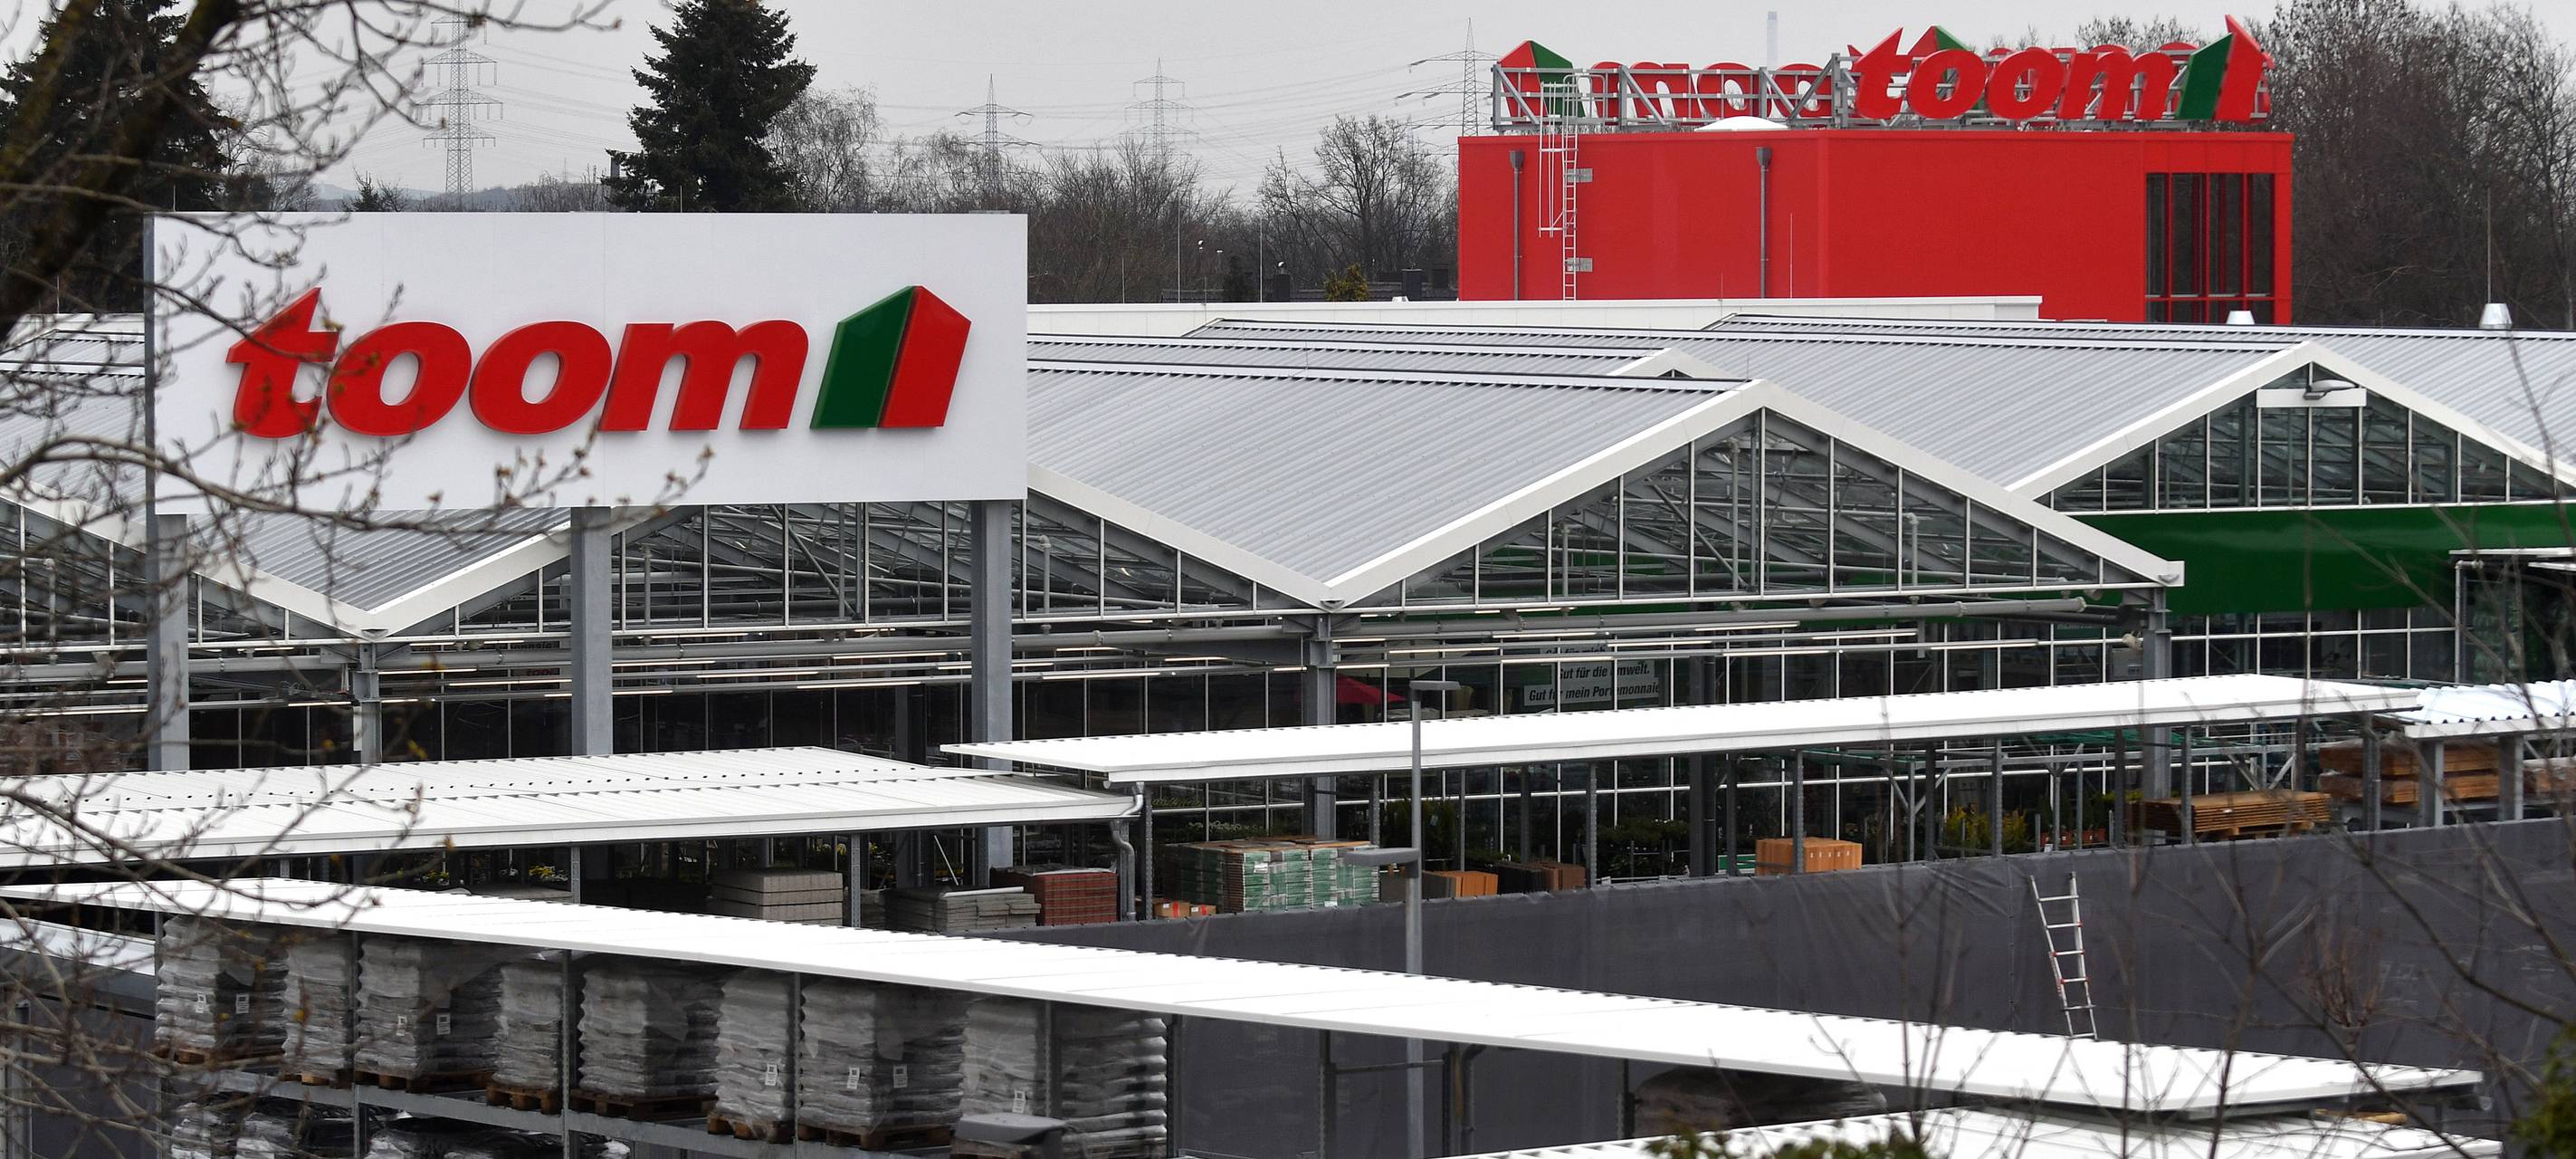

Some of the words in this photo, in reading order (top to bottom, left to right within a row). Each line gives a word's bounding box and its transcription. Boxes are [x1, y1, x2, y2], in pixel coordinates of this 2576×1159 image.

[1853, 27, 2172, 120] toom
[226, 286, 809, 438] toom
[1529, 689, 1546, 701] Gut
[1565, 686, 1590, 699] mein
[1576, 666, 1590, 678] für
[1593, 666, 1608, 677] die
[1610, 663, 1650, 676] mwelt.
